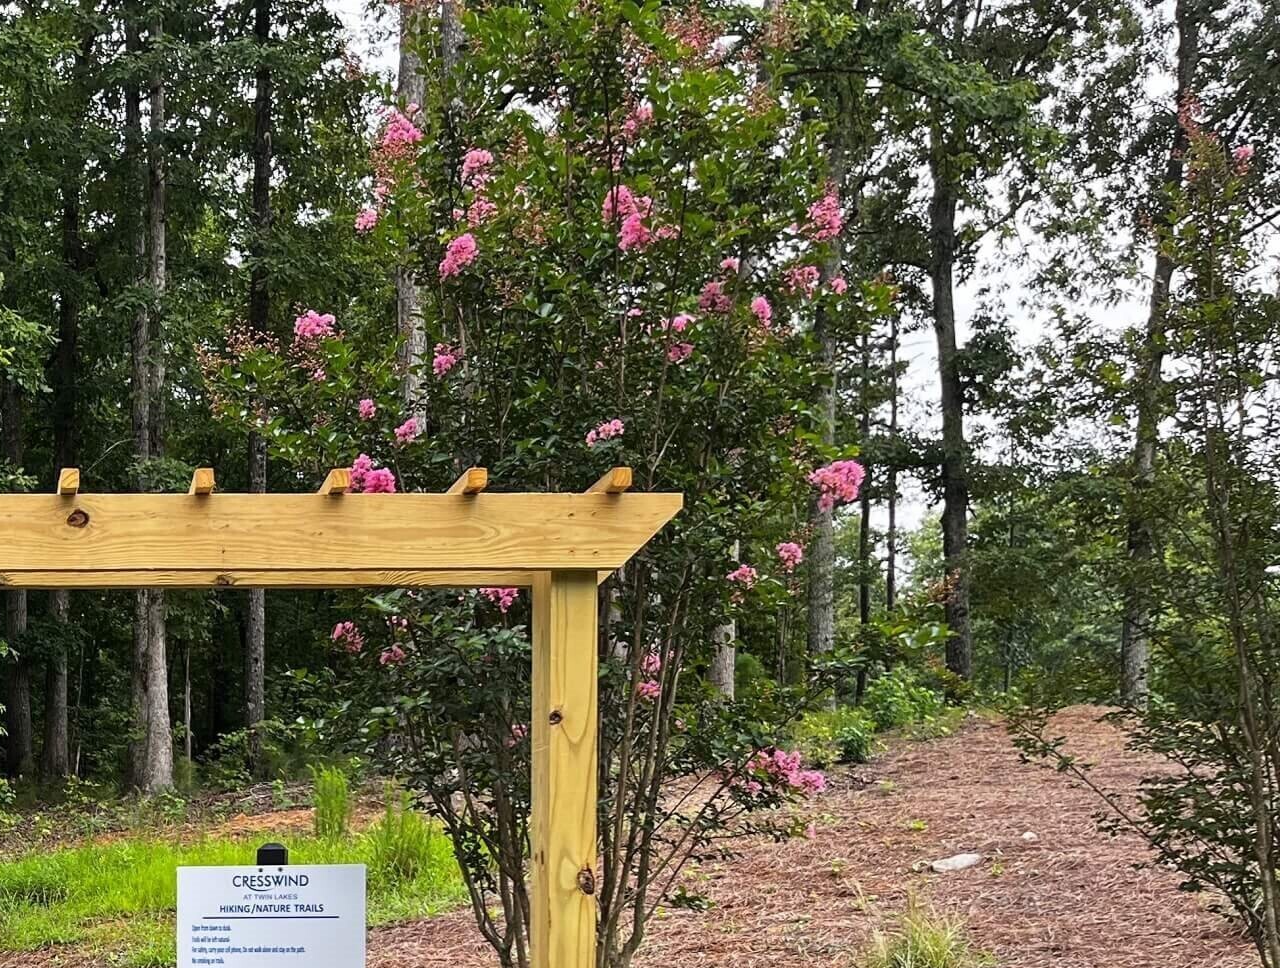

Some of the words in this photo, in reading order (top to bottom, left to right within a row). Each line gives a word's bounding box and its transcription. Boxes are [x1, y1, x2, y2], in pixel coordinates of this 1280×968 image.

[232, 875, 309, 891] CRESSWIND
[220, 904, 291, 914] HIKING/NATURE
[294, 904, 324, 912] TRAILS
